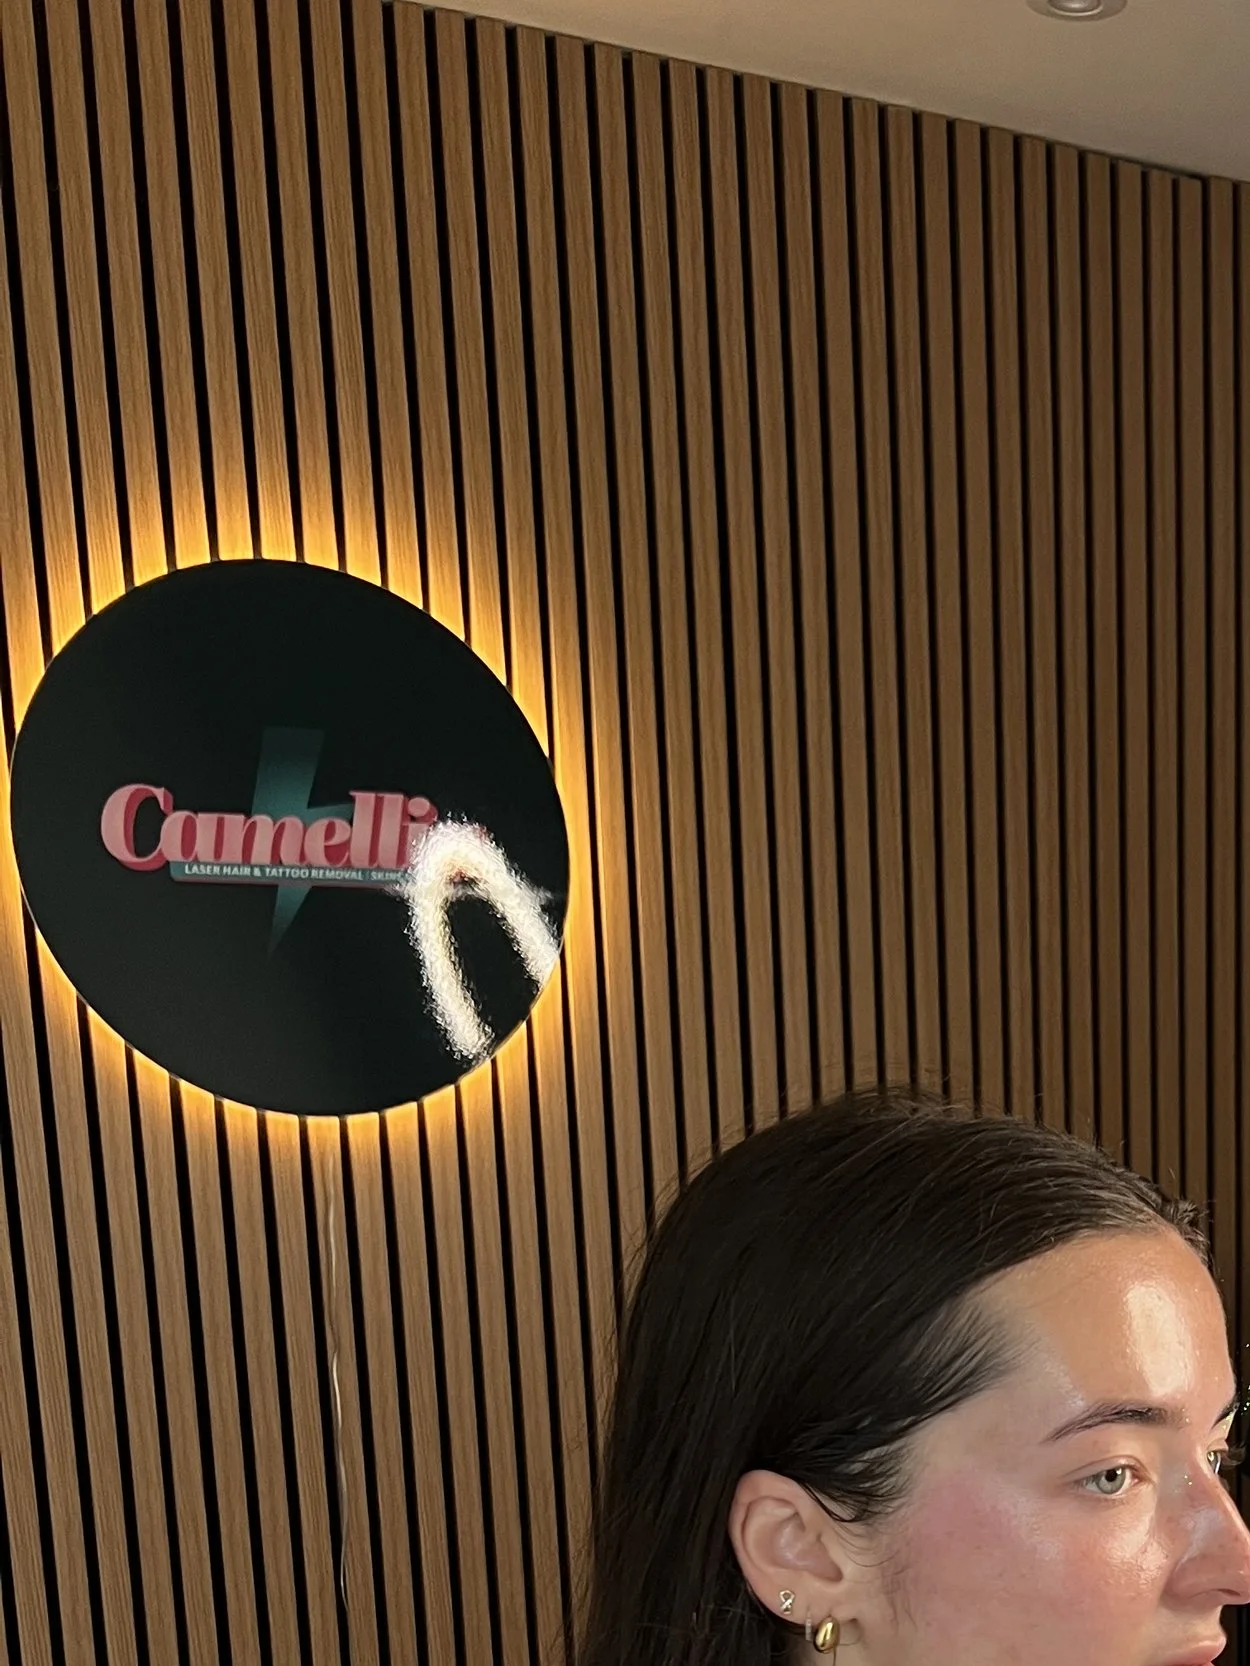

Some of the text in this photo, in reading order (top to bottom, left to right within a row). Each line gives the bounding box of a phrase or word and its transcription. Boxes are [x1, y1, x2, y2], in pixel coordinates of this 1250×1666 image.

[101, 783, 487, 871] Camelli
[185, 863, 220, 875] LASER
[223, 865, 251, 876] HAIR
[265, 867, 309, 878] TATTOO
[310, 868, 363, 880] REMOVAL
